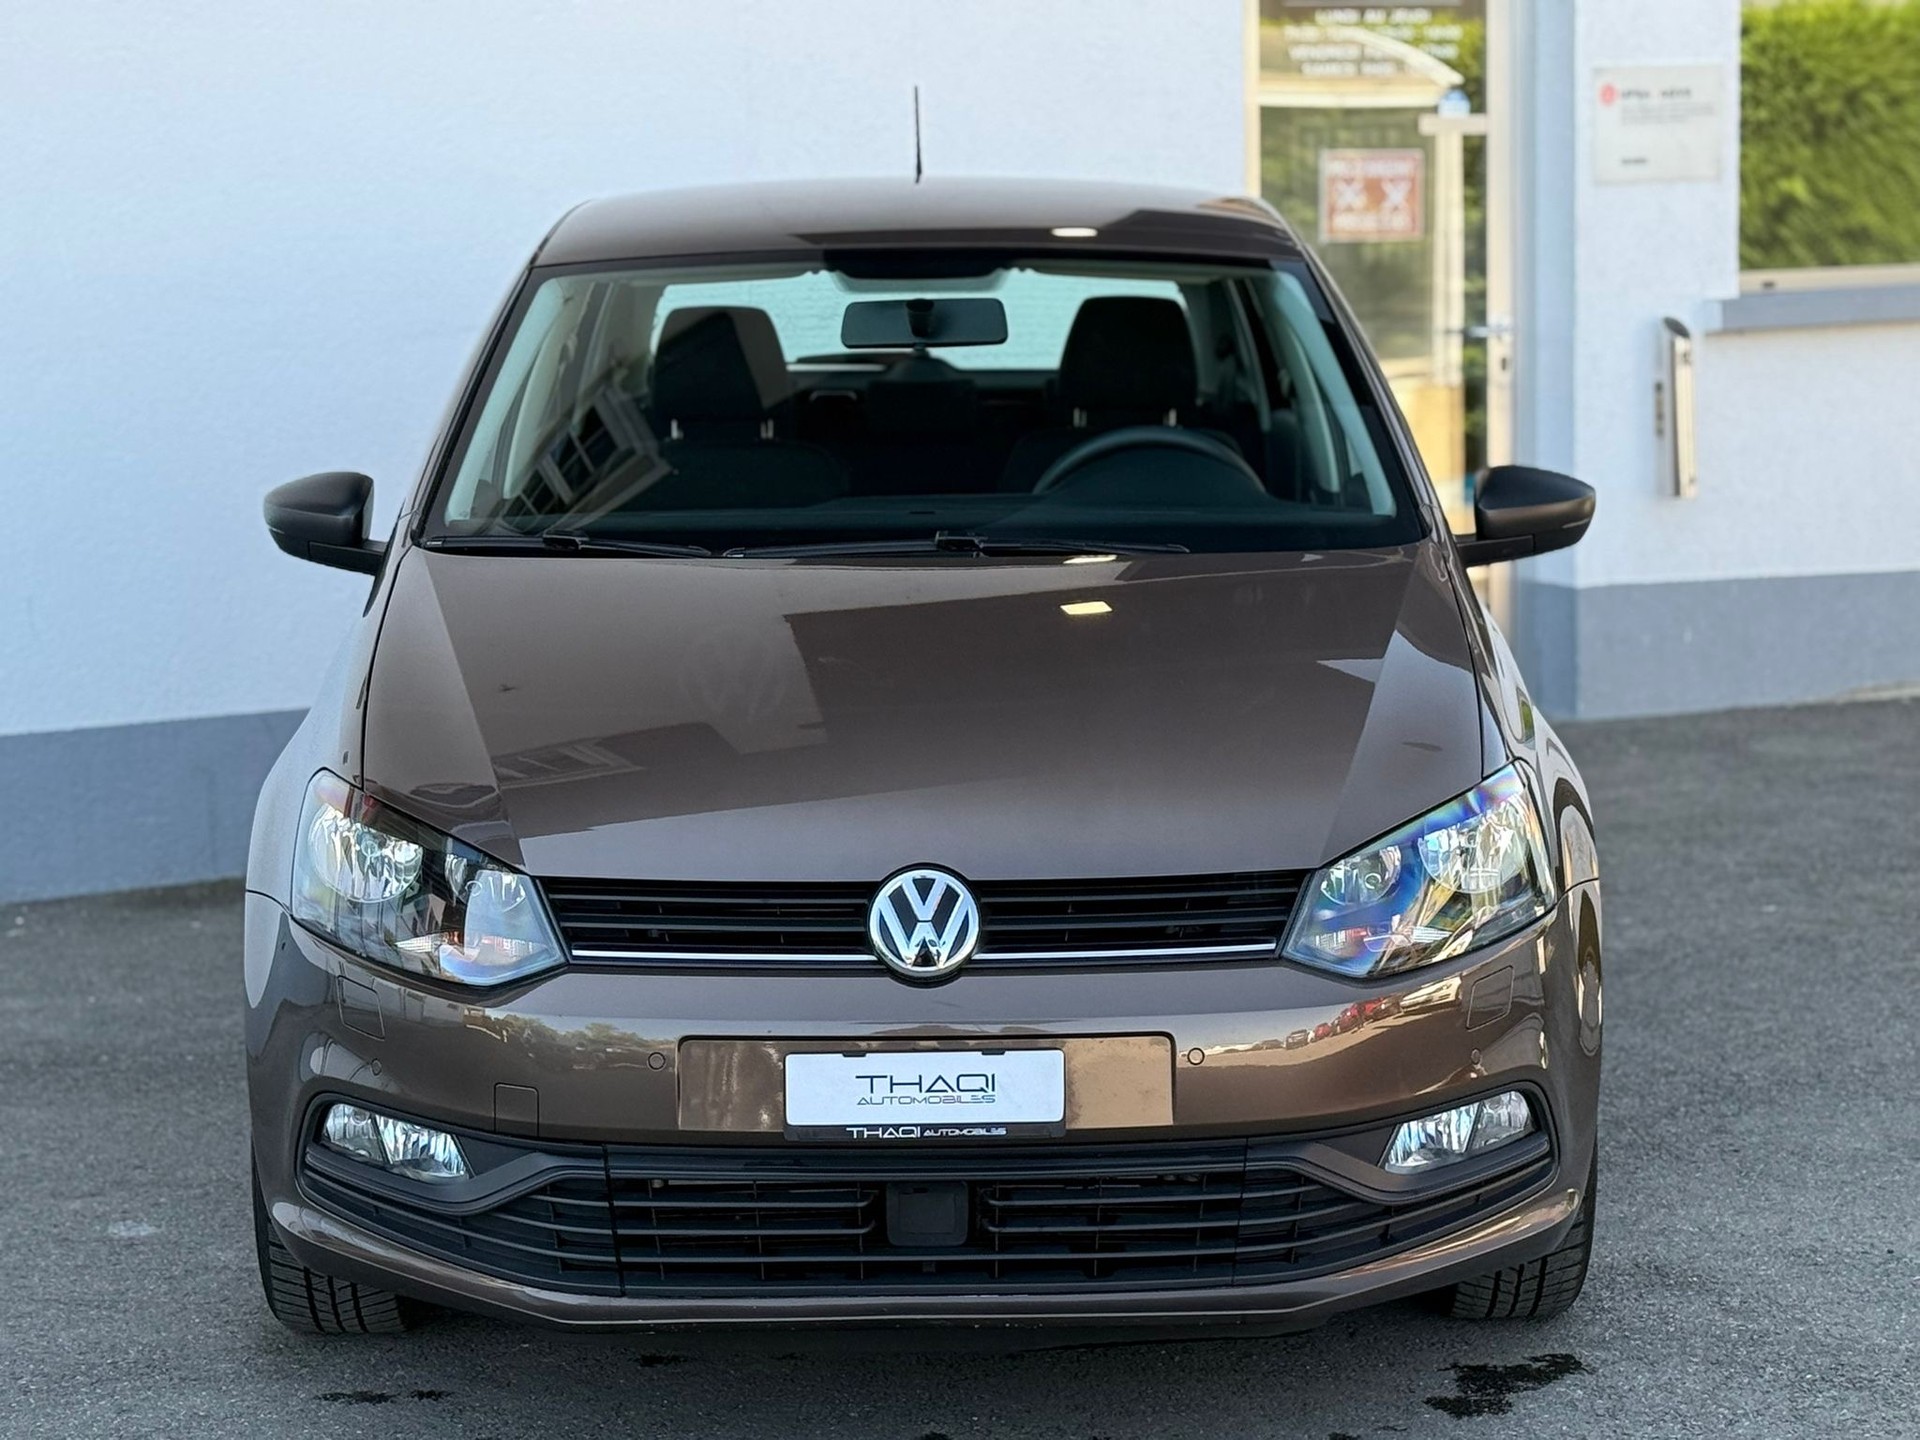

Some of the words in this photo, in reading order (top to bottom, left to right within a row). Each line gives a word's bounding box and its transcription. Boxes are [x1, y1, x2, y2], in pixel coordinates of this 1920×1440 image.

[855, 1073, 996, 1094] THAQI
[857, 1094, 996, 1106] AUTOMOBILES
[845, 1126, 921, 1139] THAQI
[923, 1127, 1007, 1137] AUTOMOBILES
